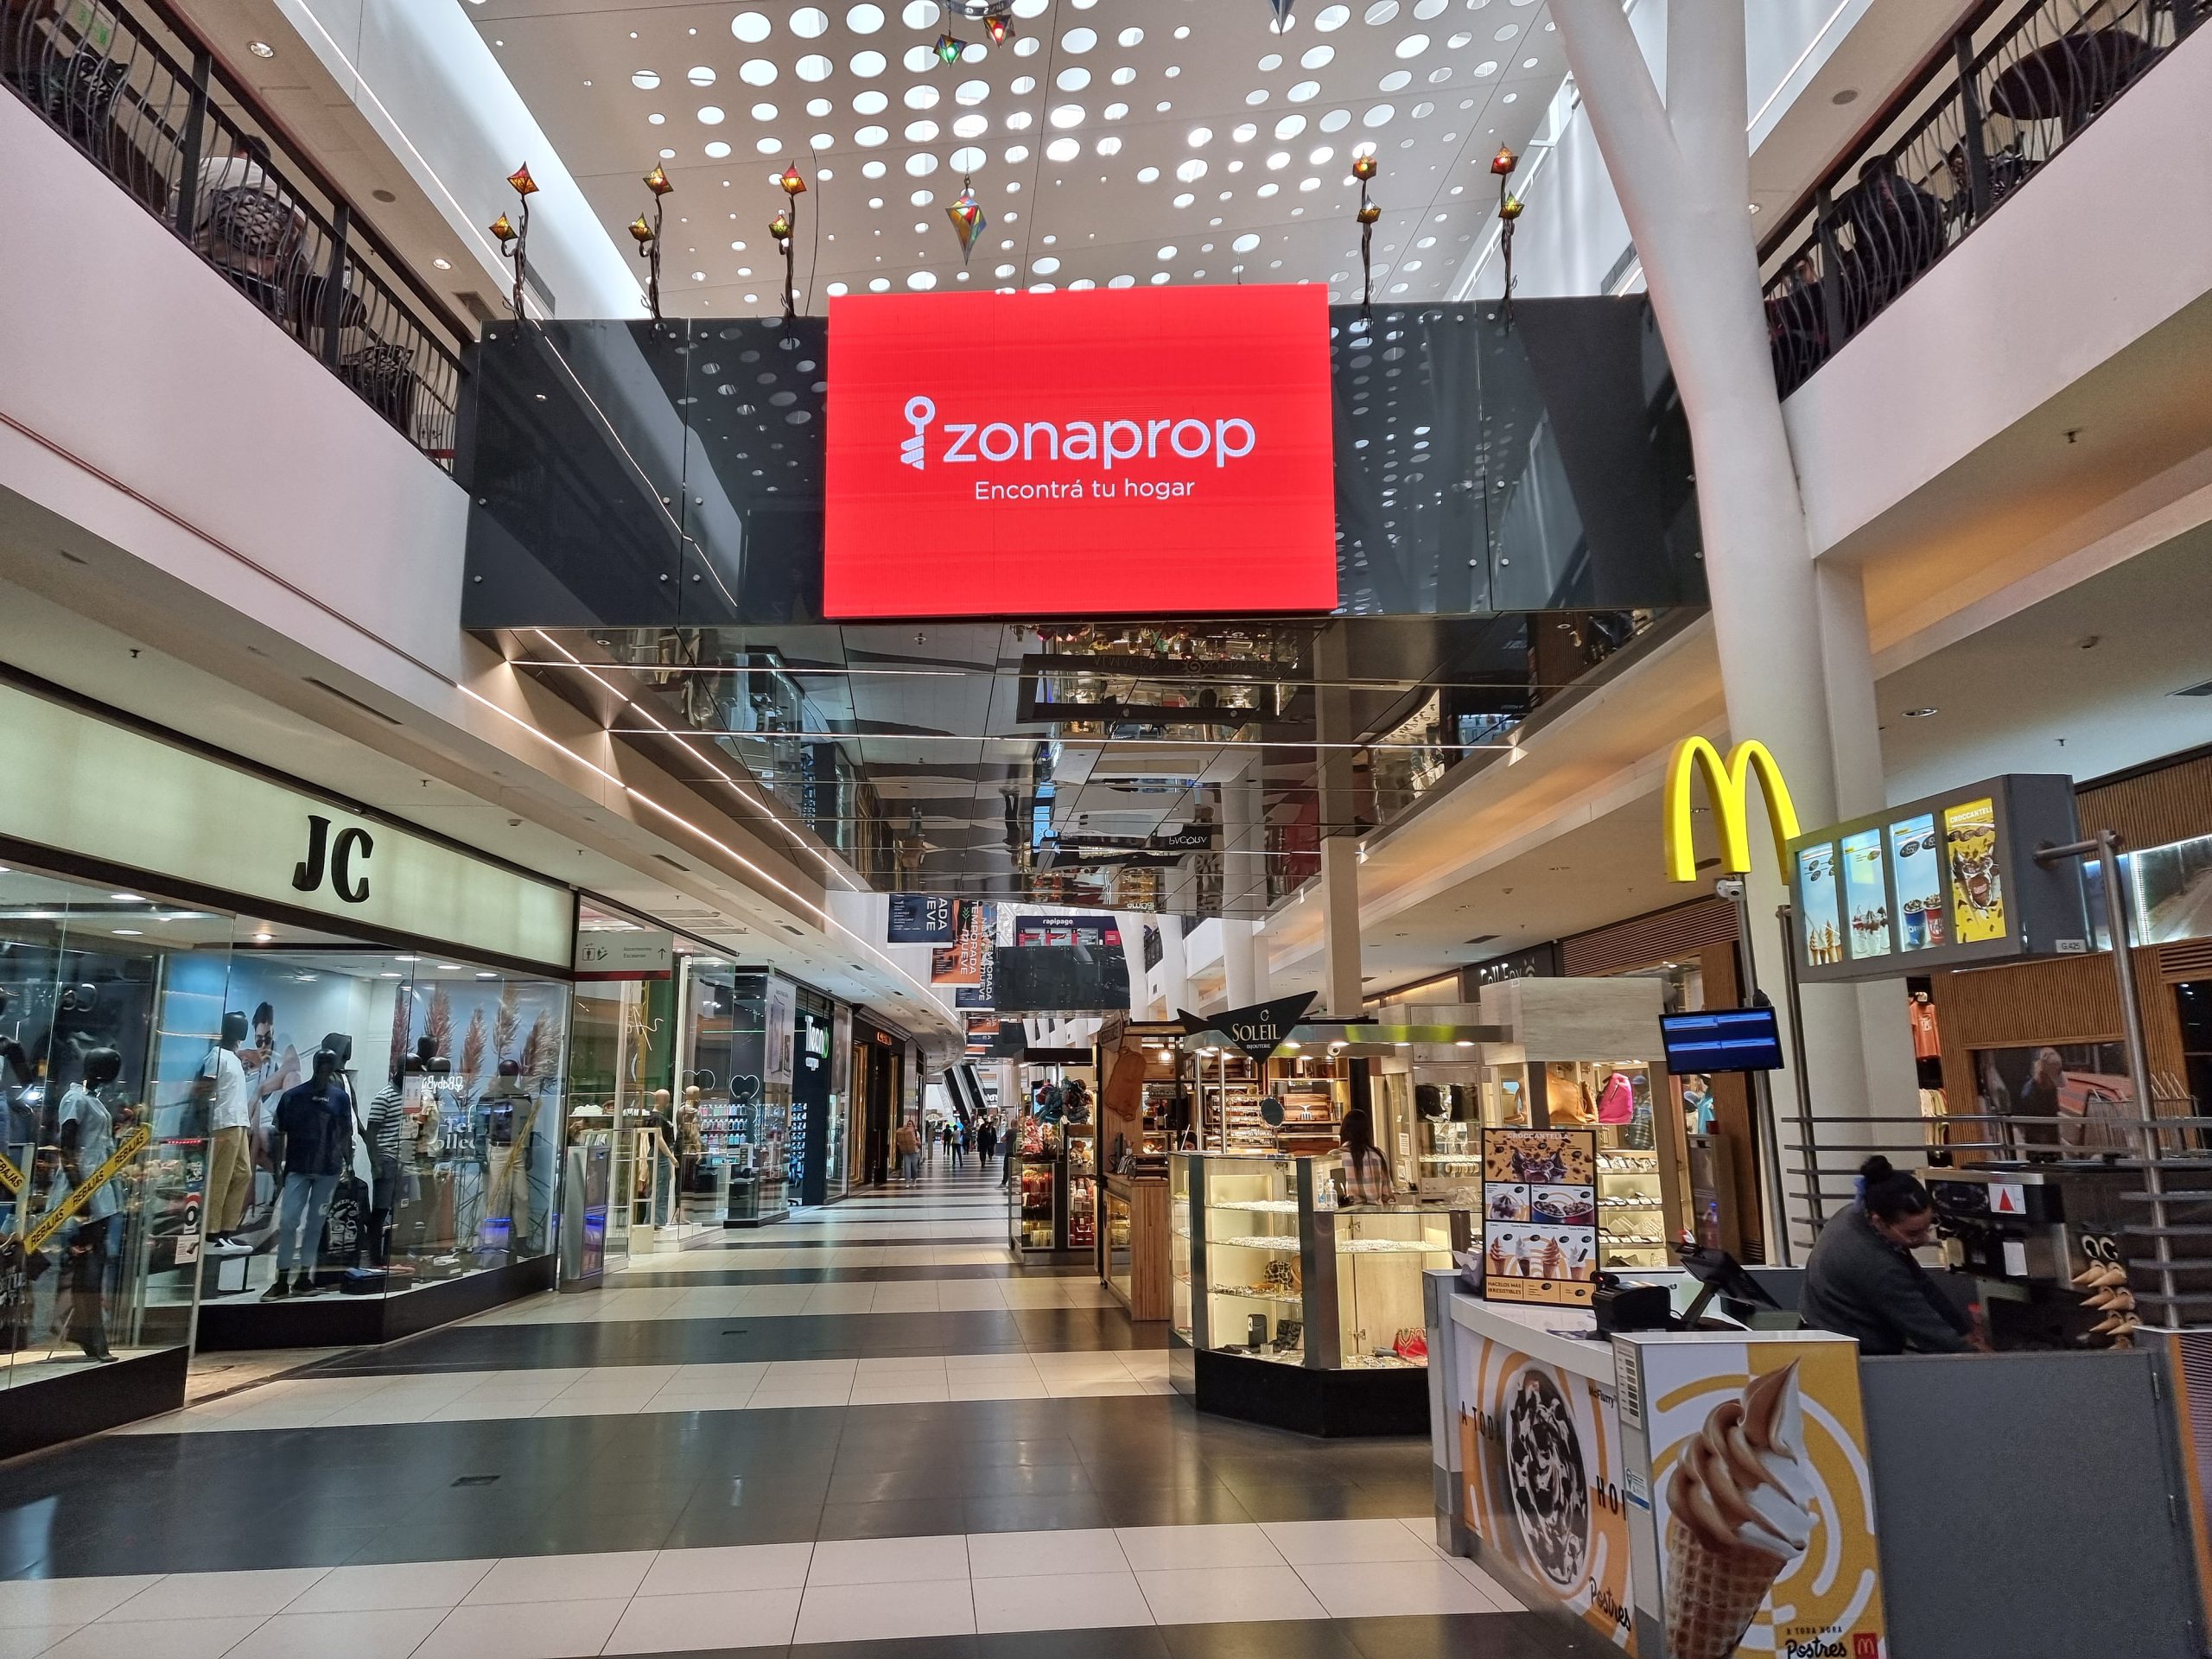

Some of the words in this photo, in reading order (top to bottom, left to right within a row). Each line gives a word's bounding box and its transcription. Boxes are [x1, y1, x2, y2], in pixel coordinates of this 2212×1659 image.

[943, 418, 1255, 470] zonaprop
[976, 480, 1083, 500] Encontrá
[1092, 481, 1116, 499] tu
[1124, 478, 1195, 500] hogar
[292, 815, 373, 903] JC
[969, 899, 980, 975] TEMPORADA
[1042, 918, 1074, 926] rapipago
[1232, 1023, 1281, 1043] SOLEIL
[114, 1133, 145, 1166] REBAJAS
[72, 1170, 105, 1205] REBAJAS
[30, 1209, 65, 1248] REBAJAS
[1461, 1401, 1468, 1426] A
[1597, 1475, 1626, 1521] HO
[1589, 1576, 1631, 1632] Postres
[1785, 1637, 1847, 1659] Postres
